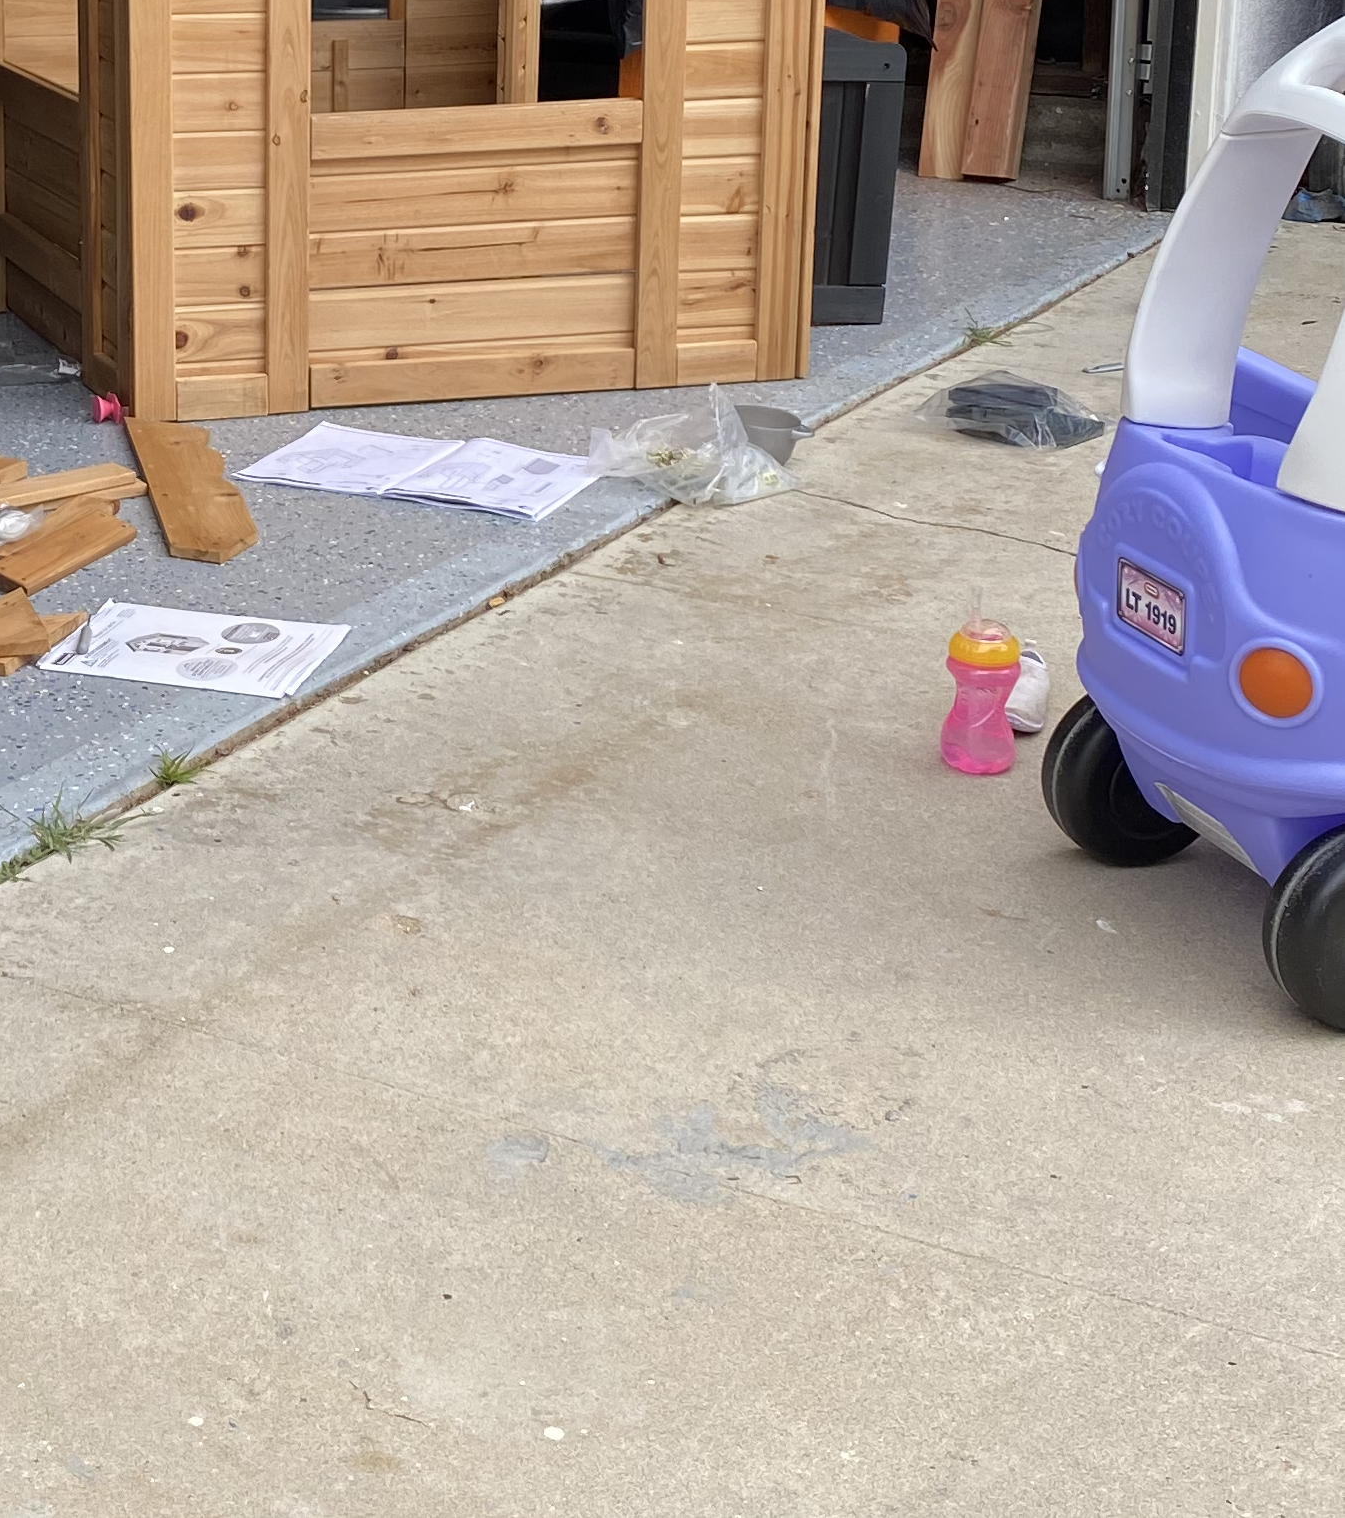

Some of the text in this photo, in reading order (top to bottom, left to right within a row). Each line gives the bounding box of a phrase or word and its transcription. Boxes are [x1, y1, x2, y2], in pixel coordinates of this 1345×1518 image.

[1098, 500, 1143, 548] COZY
[1125, 587, 1177, 634] LT 1919
